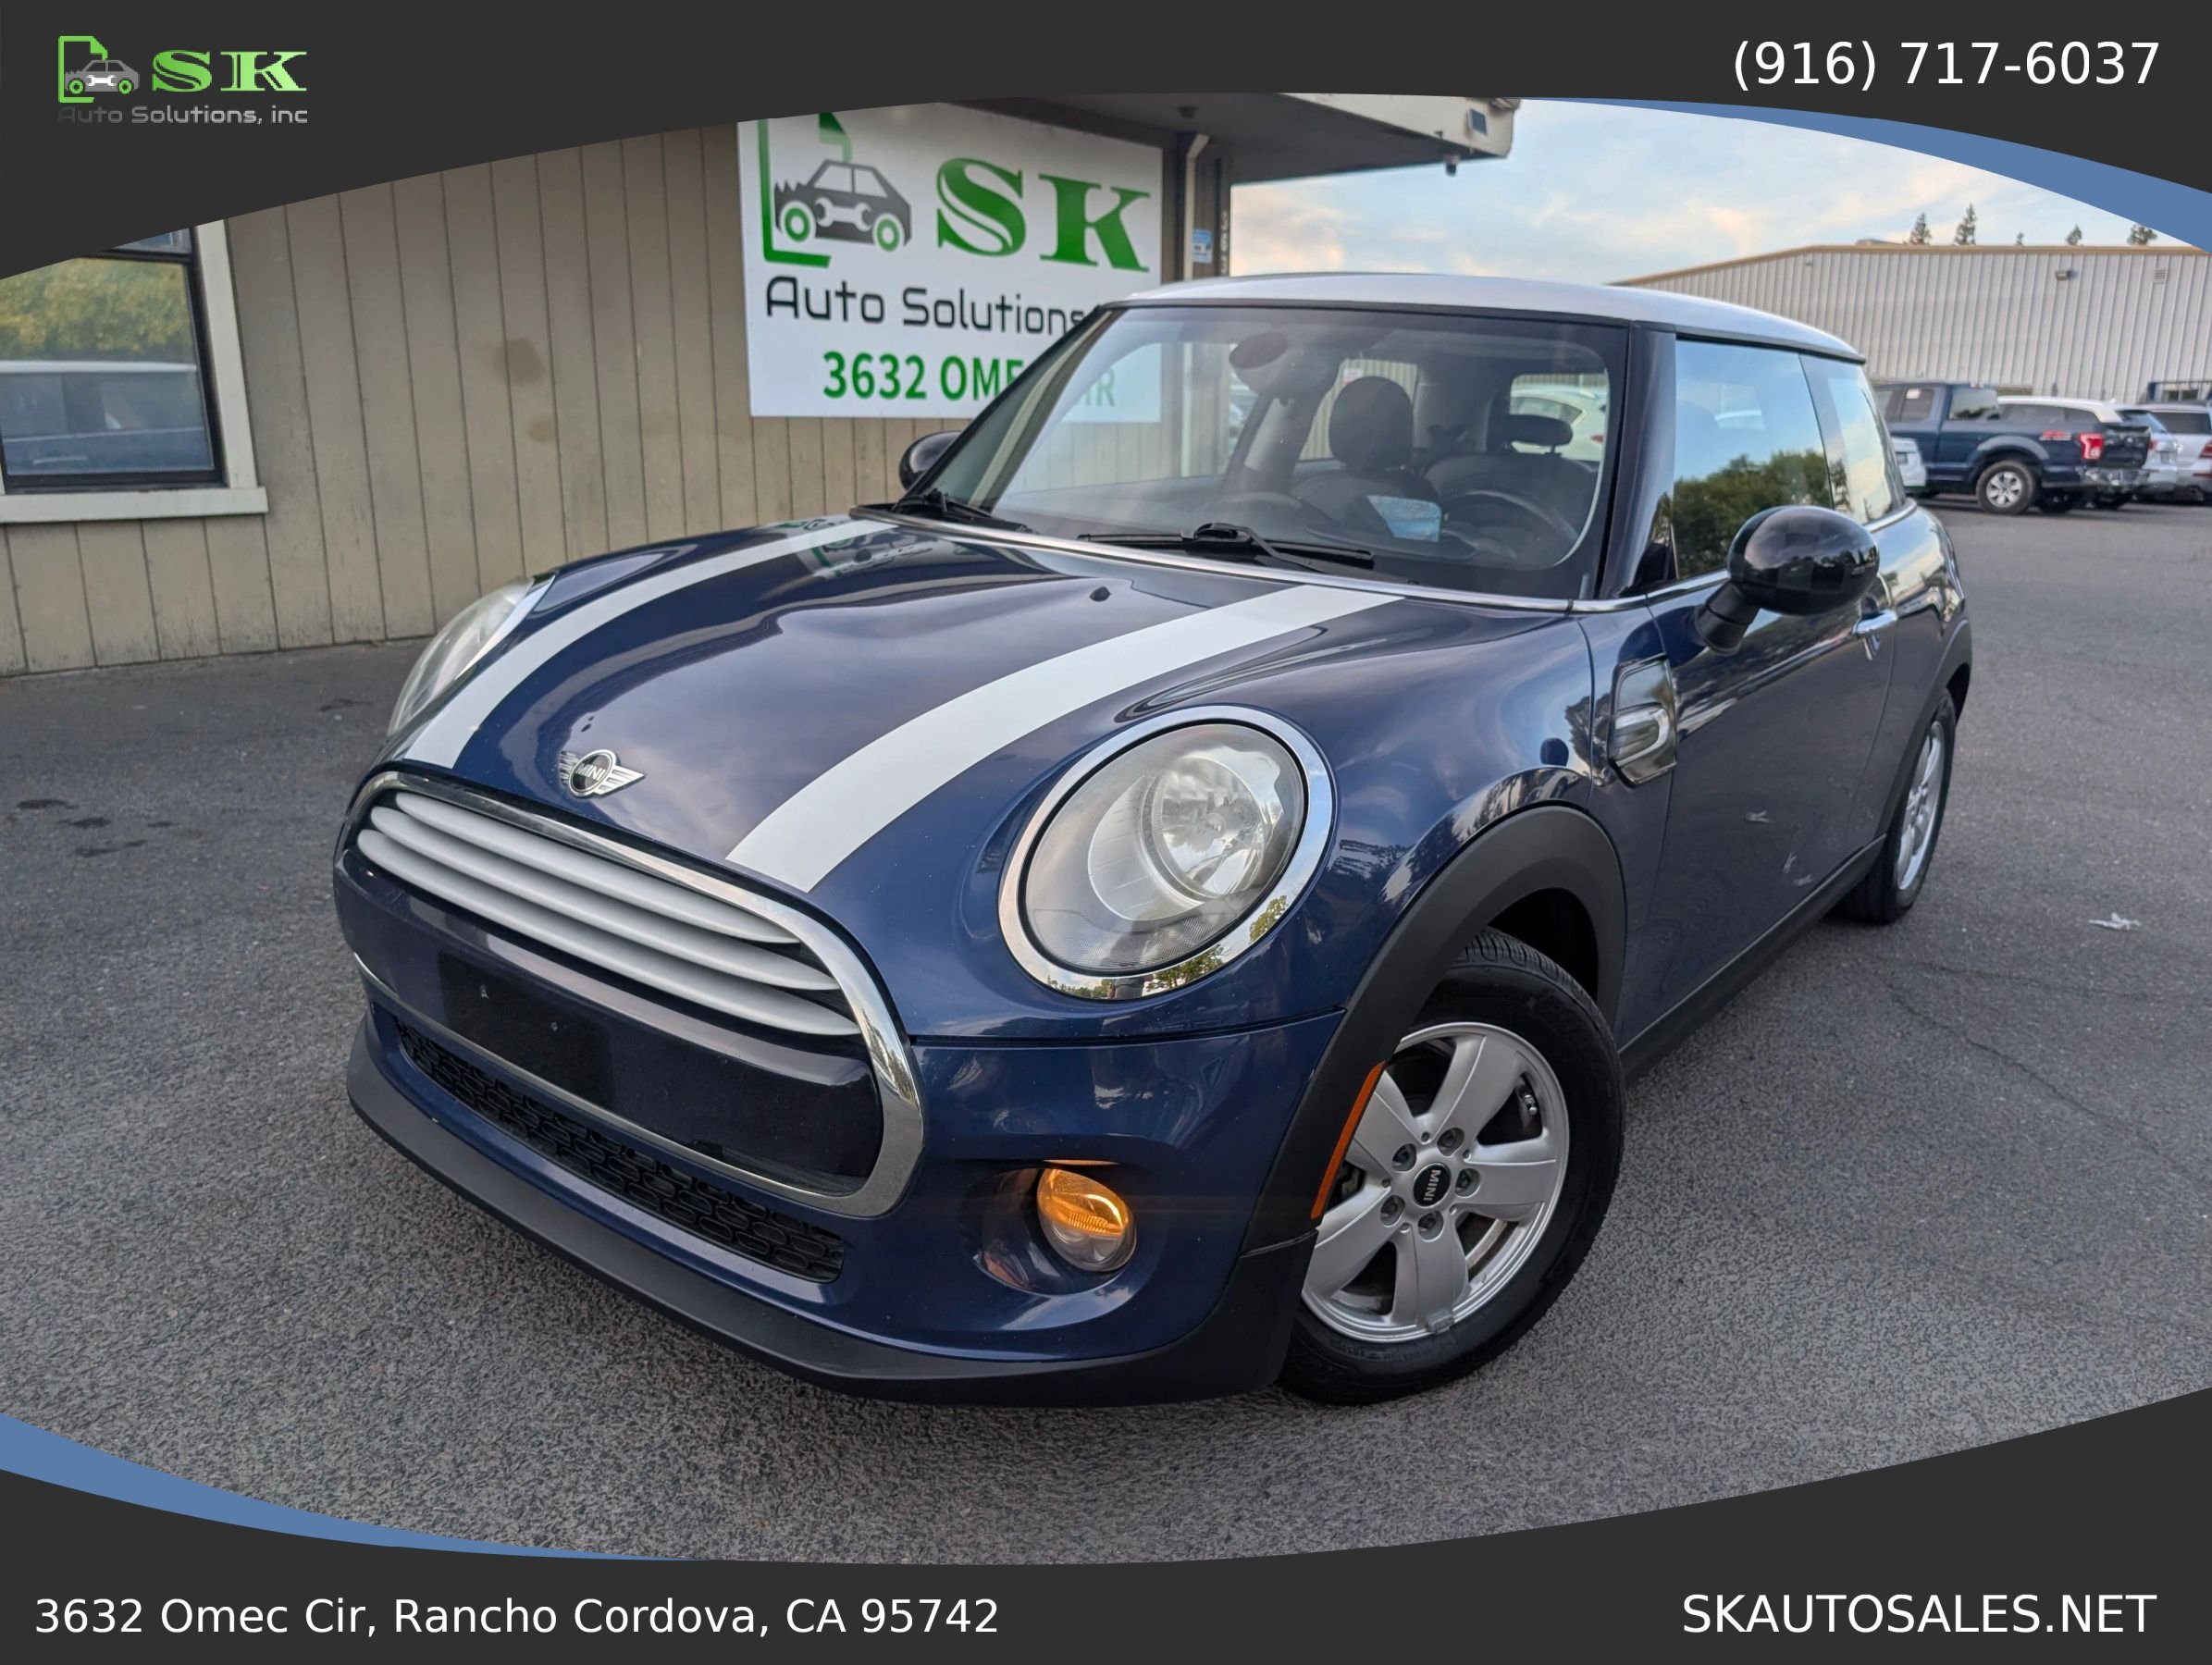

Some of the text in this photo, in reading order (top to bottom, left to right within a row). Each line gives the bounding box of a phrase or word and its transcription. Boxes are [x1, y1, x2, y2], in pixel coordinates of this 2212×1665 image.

[936, 159, 1150, 272] SK
[766, 275, 884, 325] Auto
[822, 351, 927, 400] 3632
[575, 762, 607, 782] MINI
[1423, 1169, 1442, 1202] MINI
